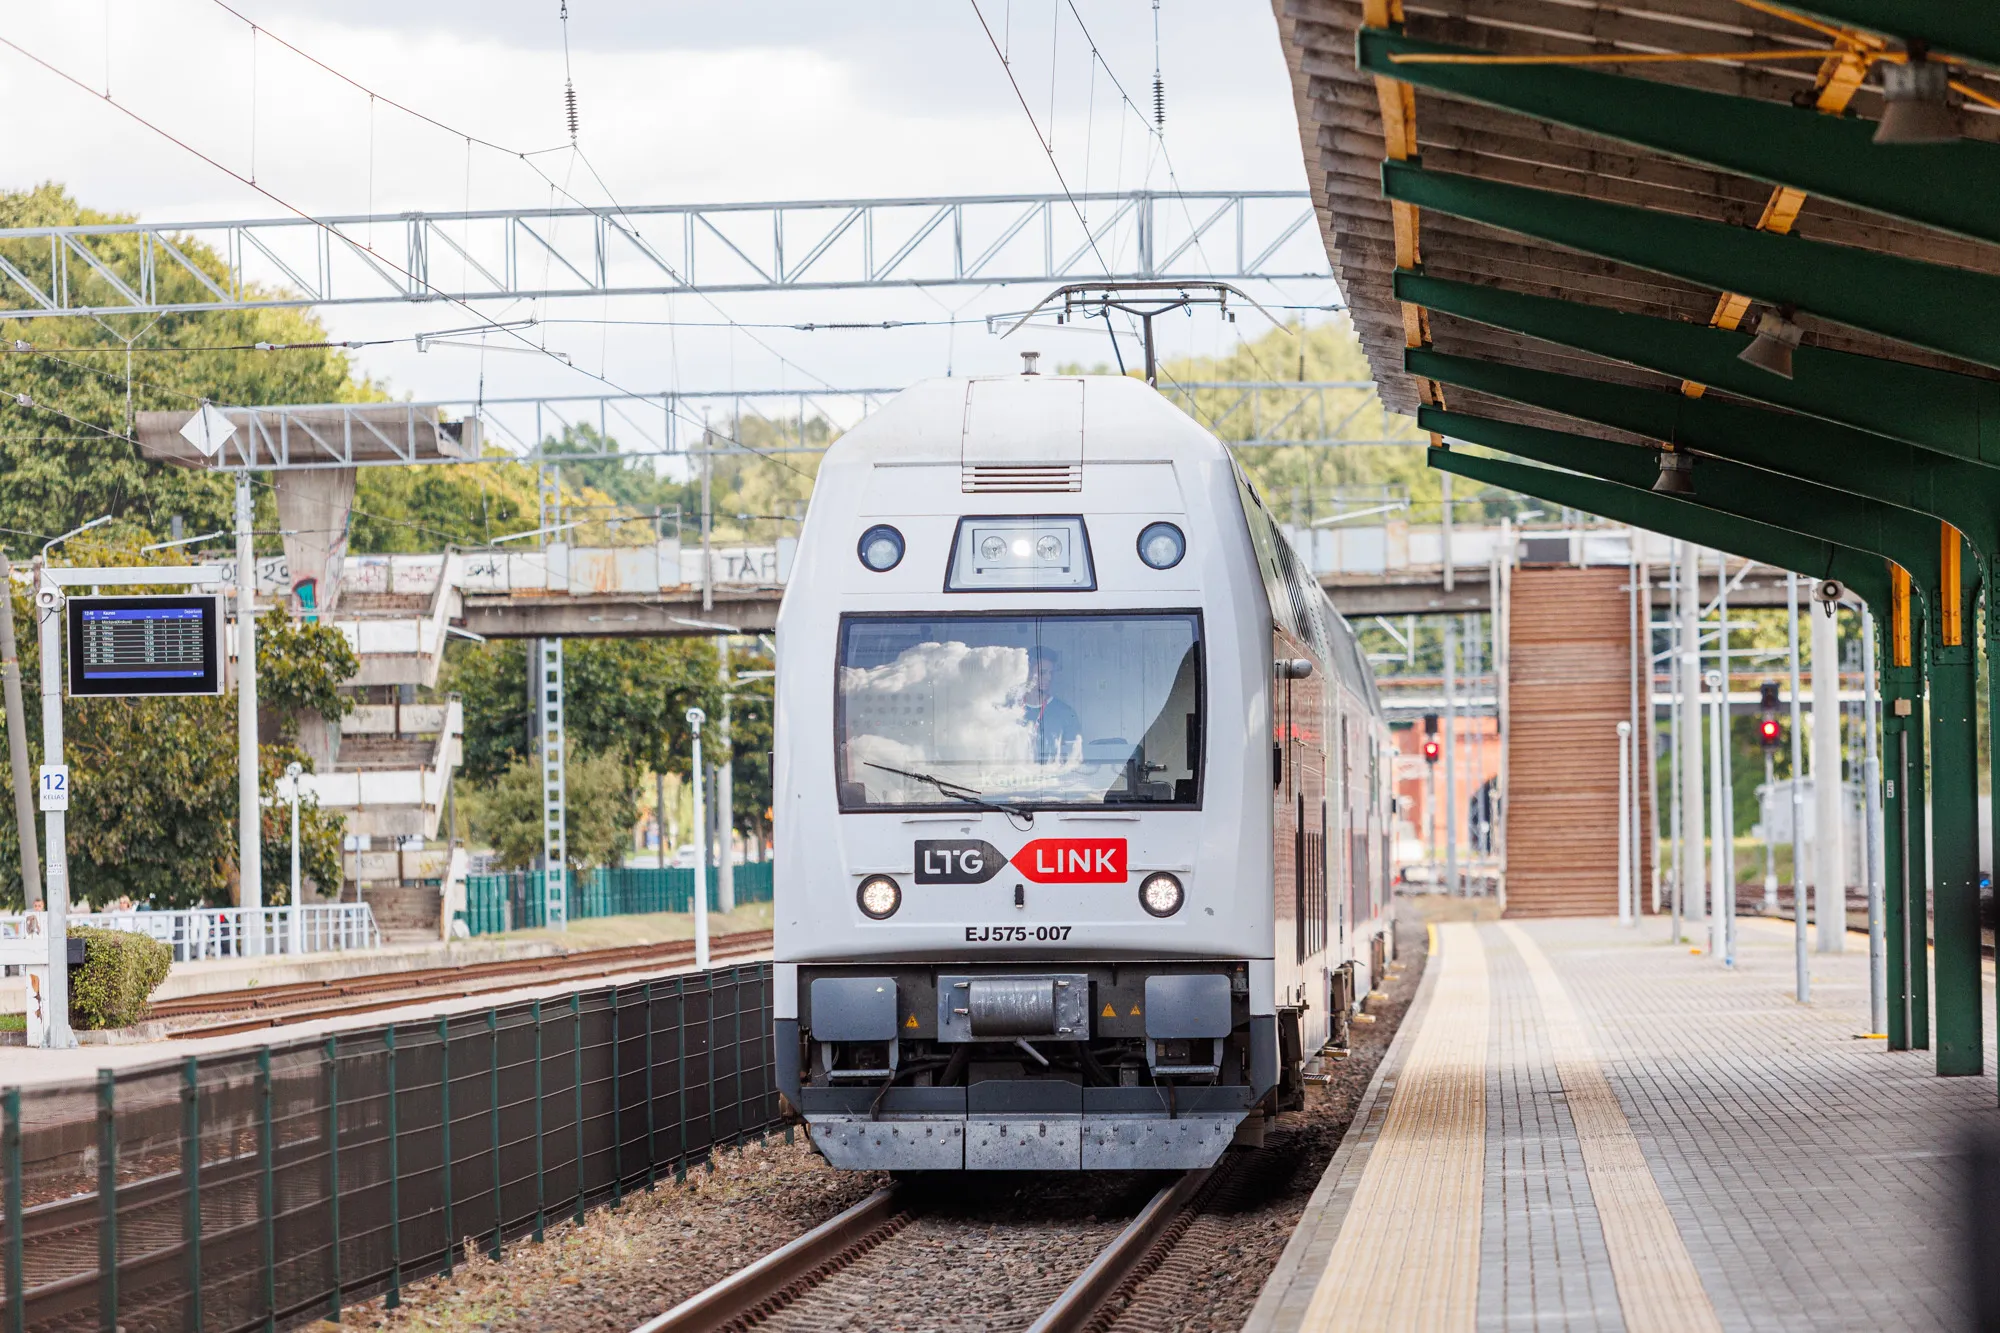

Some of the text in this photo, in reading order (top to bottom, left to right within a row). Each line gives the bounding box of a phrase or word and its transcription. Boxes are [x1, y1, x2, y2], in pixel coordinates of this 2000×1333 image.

[43, 773, 65, 790] 12
[924, 848, 1118, 875] LTG LINK
[965, 926, 1072, 942] EJ575-007
